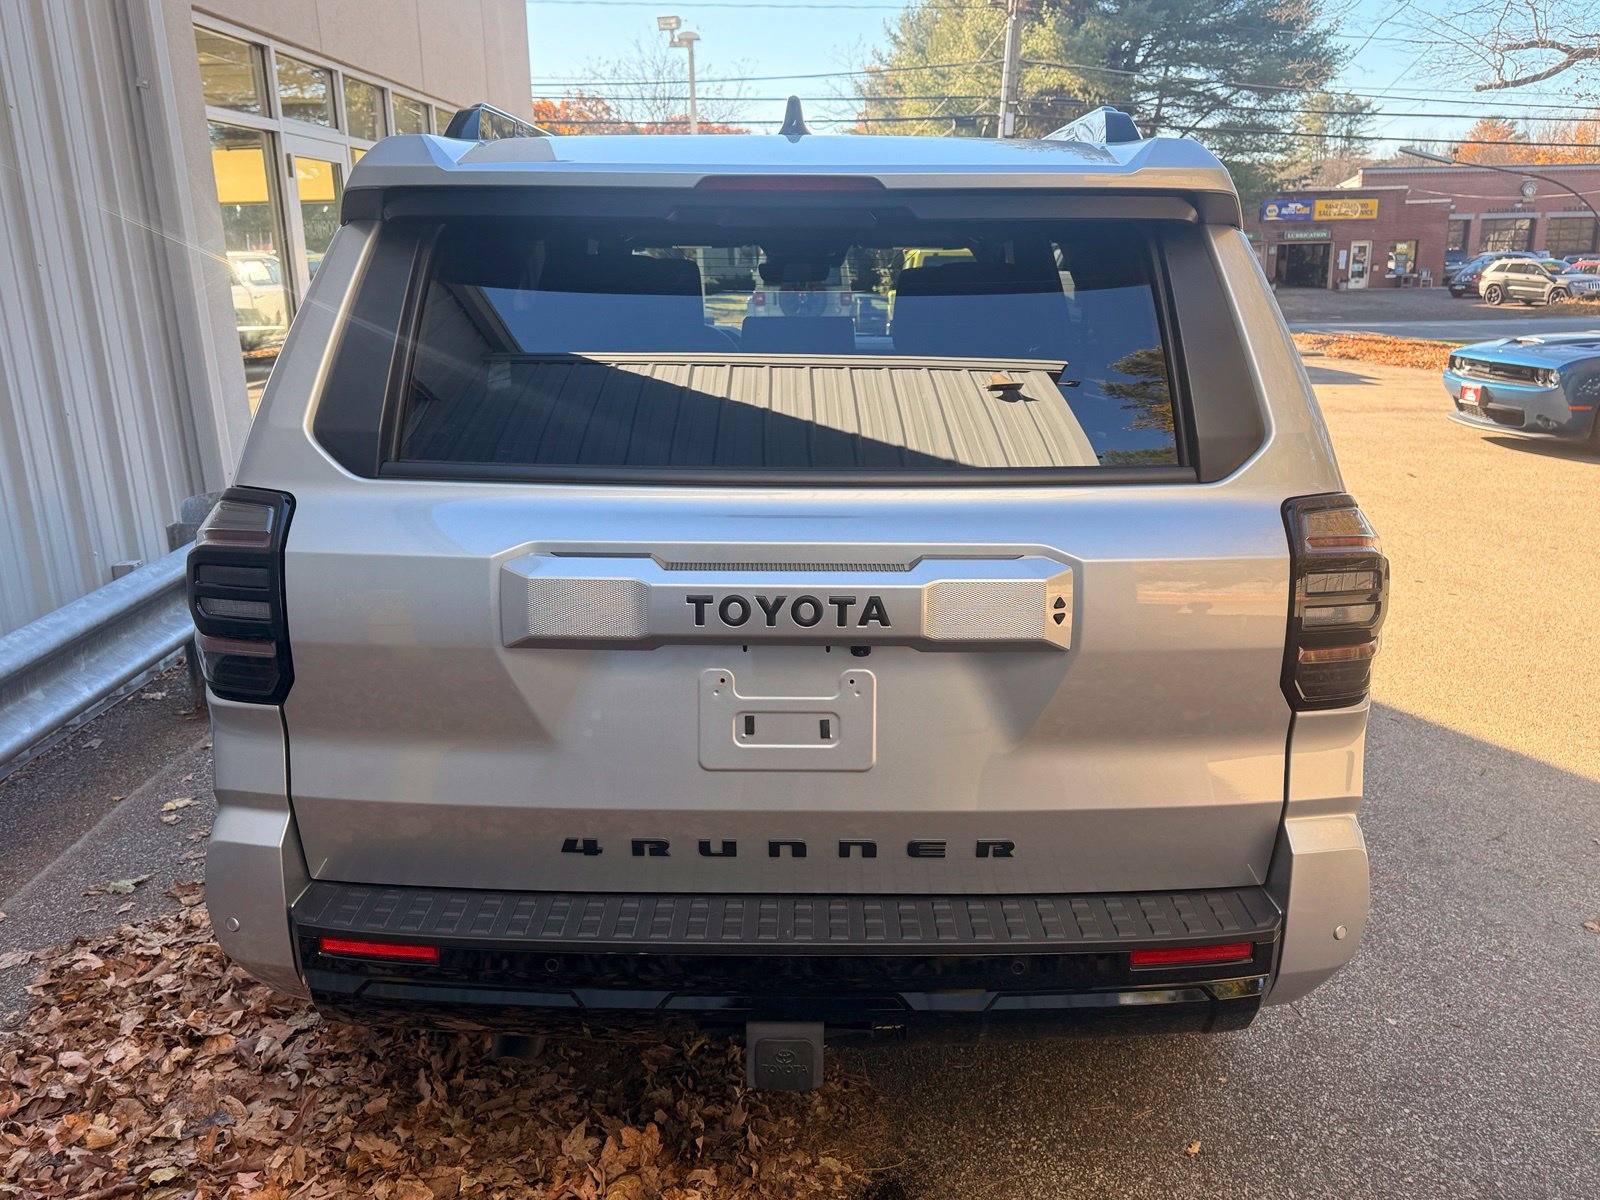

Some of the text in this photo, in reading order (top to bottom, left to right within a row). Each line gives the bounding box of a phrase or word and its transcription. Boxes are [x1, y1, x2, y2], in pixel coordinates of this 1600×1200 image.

[1287, 231, 1327, 239] LUBRICATION
[685, 594, 892, 628] TOYOTA
[561, 837, 1016, 858] 4RUNNER
[761, 1063, 809, 1074] TOYOTA
